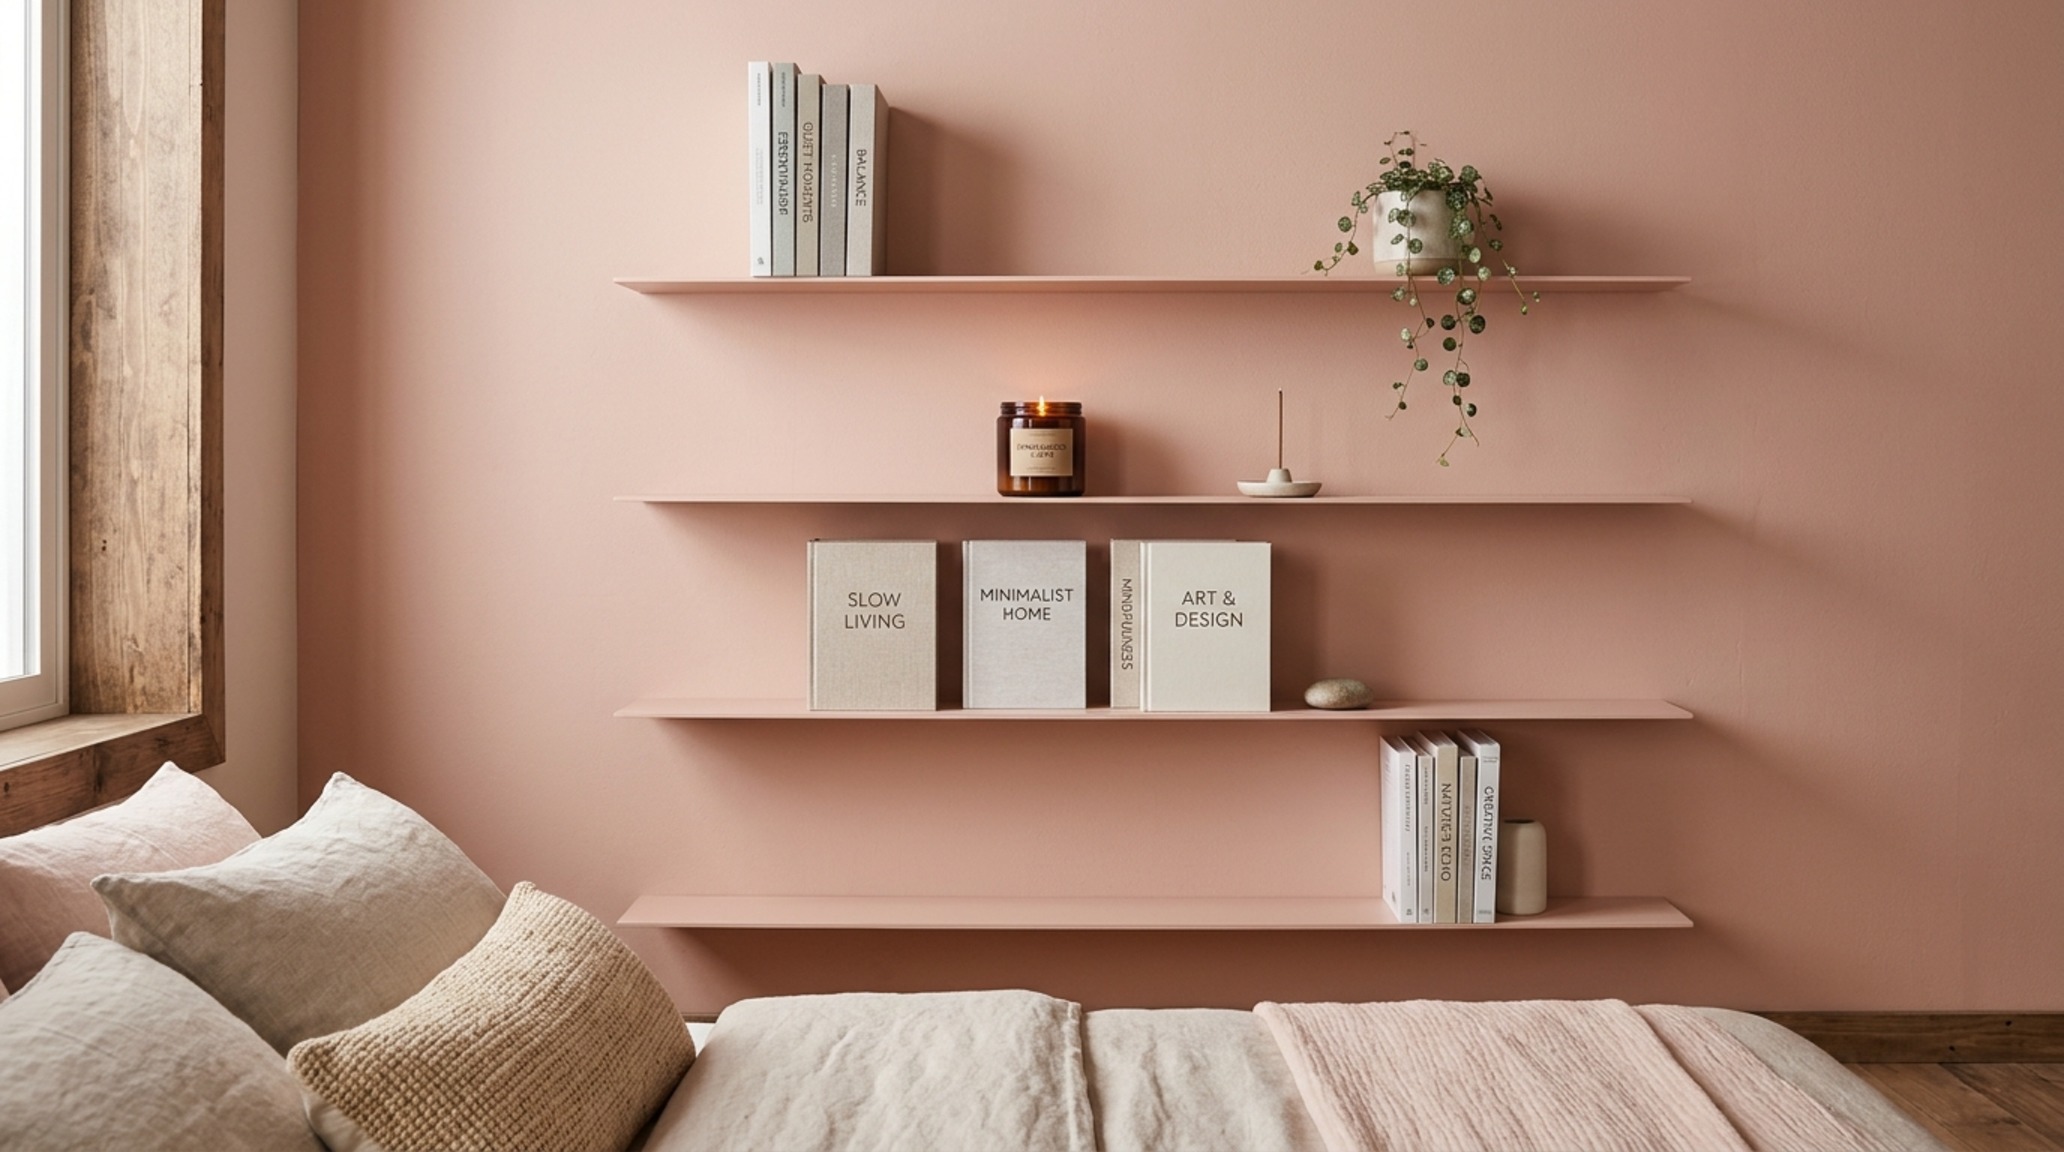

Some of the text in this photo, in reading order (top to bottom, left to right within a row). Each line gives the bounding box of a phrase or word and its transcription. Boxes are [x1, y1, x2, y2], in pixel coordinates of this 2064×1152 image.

[855, 148, 867, 207] BALANCE
[848, 592, 901, 608] SLOW
[980, 588, 1074, 602] MINIMALIST
[1181, 590, 1236, 606] ART &
[844, 614, 906, 629] LIVING
[1002, 607, 1051, 621] HOME
[1175, 611, 1243, 627] DESIGN
